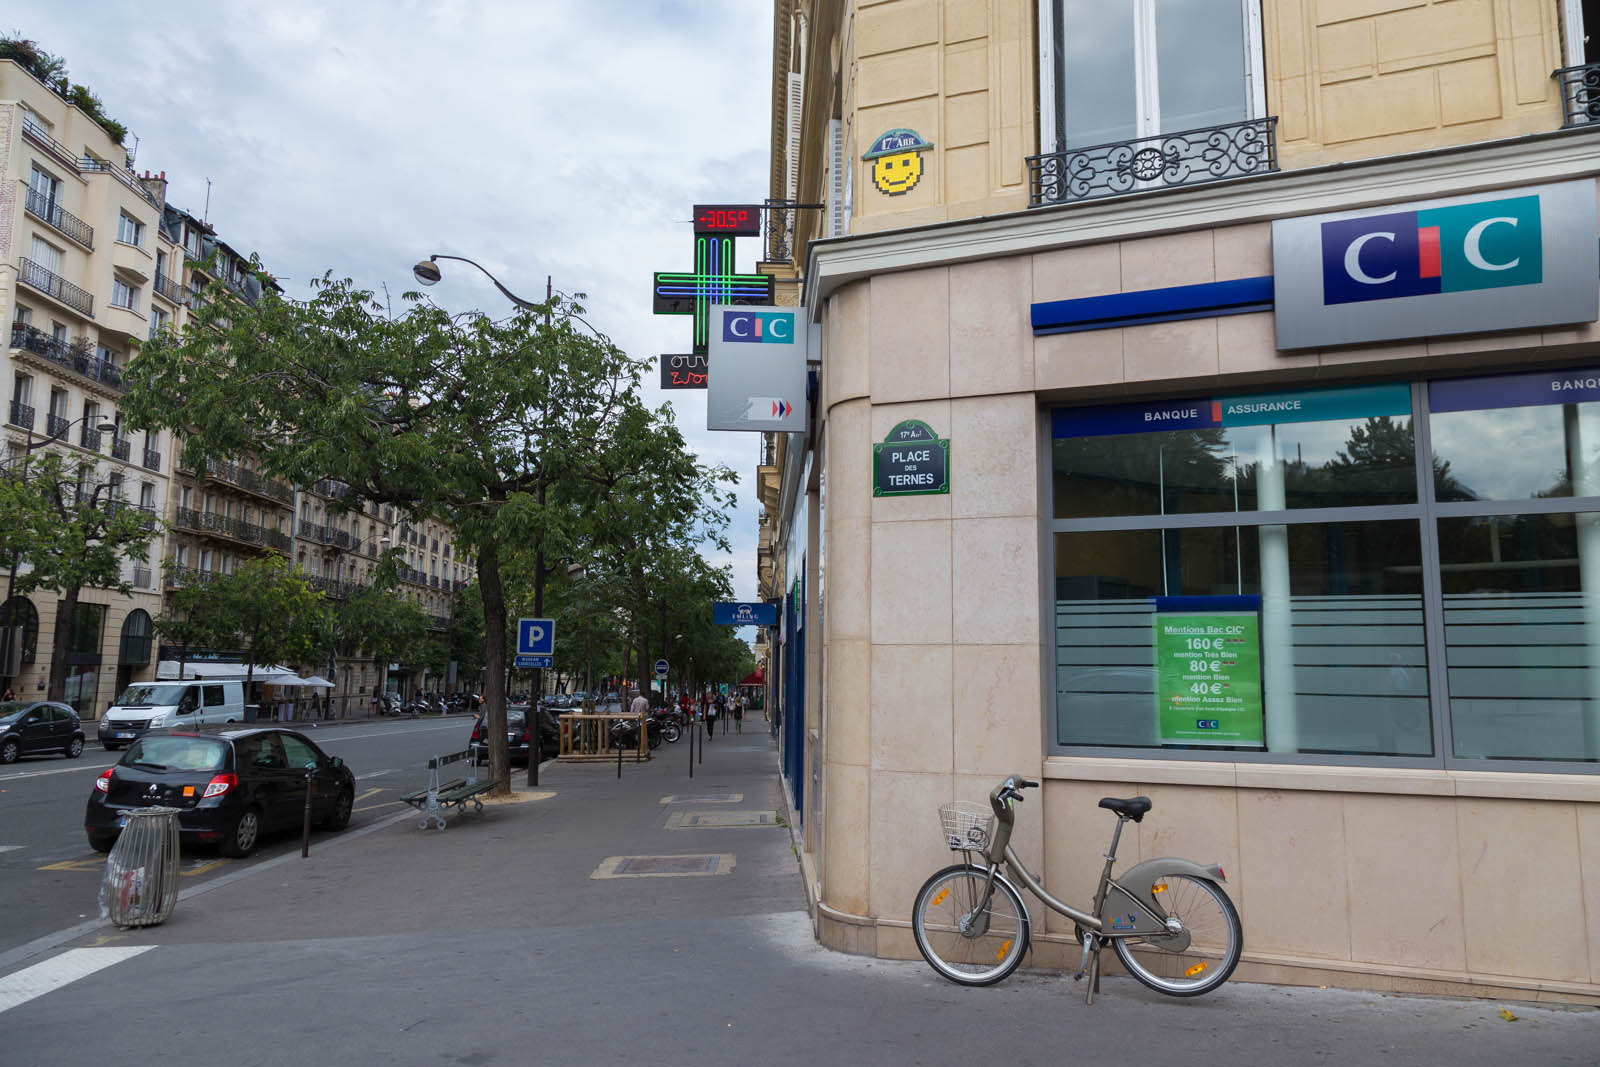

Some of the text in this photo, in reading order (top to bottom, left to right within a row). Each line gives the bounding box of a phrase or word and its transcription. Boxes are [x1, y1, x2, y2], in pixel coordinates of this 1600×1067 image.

[1343, 216, 1520, 285] CIC
[729, 317, 788, 338] CIC
[1551, 378, 1600, 391] BANQ
[1144, 400, 1302, 421] BANQUE ASSURANCE
[891, 450, 930, 463] PLACE
[904, 464, 917, 472] DES
[888, 472, 935, 486] TERNES
[1164, 625, 1205, 633] Mentions
[1207, 625, 1224, 633] Bac
[529, 625, 545, 648] P
